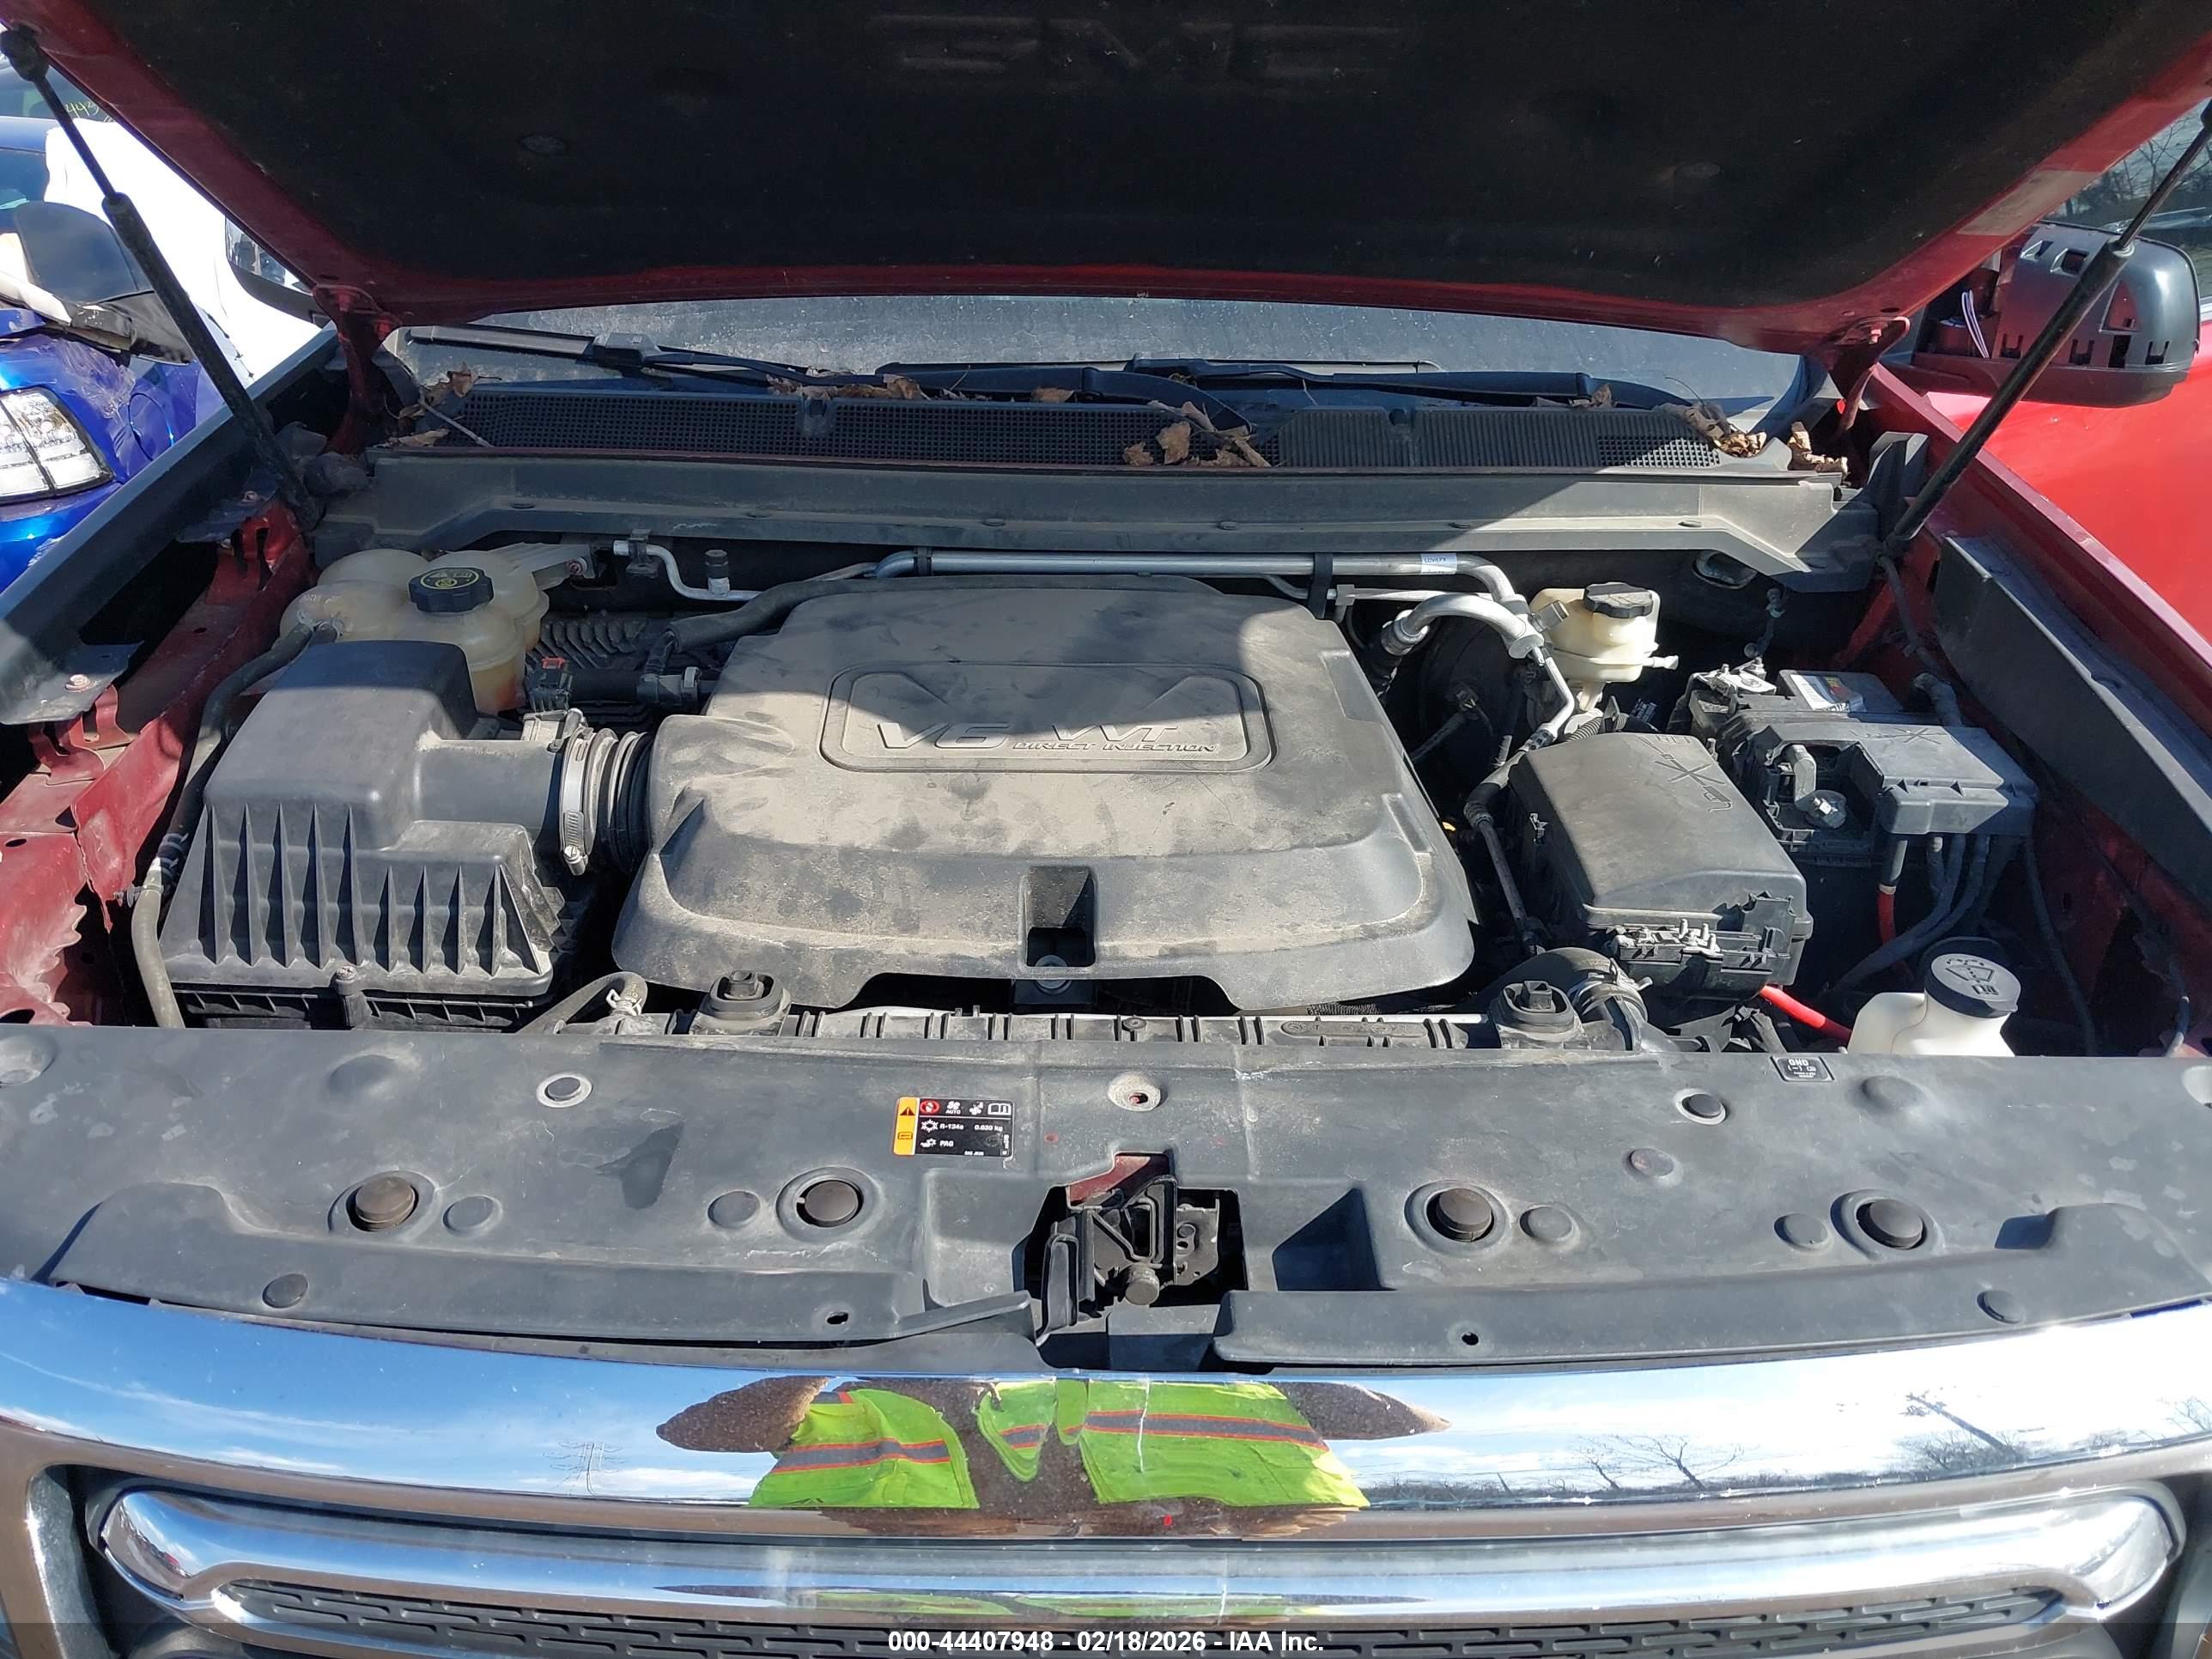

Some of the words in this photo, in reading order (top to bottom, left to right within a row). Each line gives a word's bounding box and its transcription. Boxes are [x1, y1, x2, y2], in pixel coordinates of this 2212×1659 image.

[877, 722, 1010, 749] V6
[1052, 725, 1177, 742] VVT
[1102, 743, 1219, 752] INJECTION
